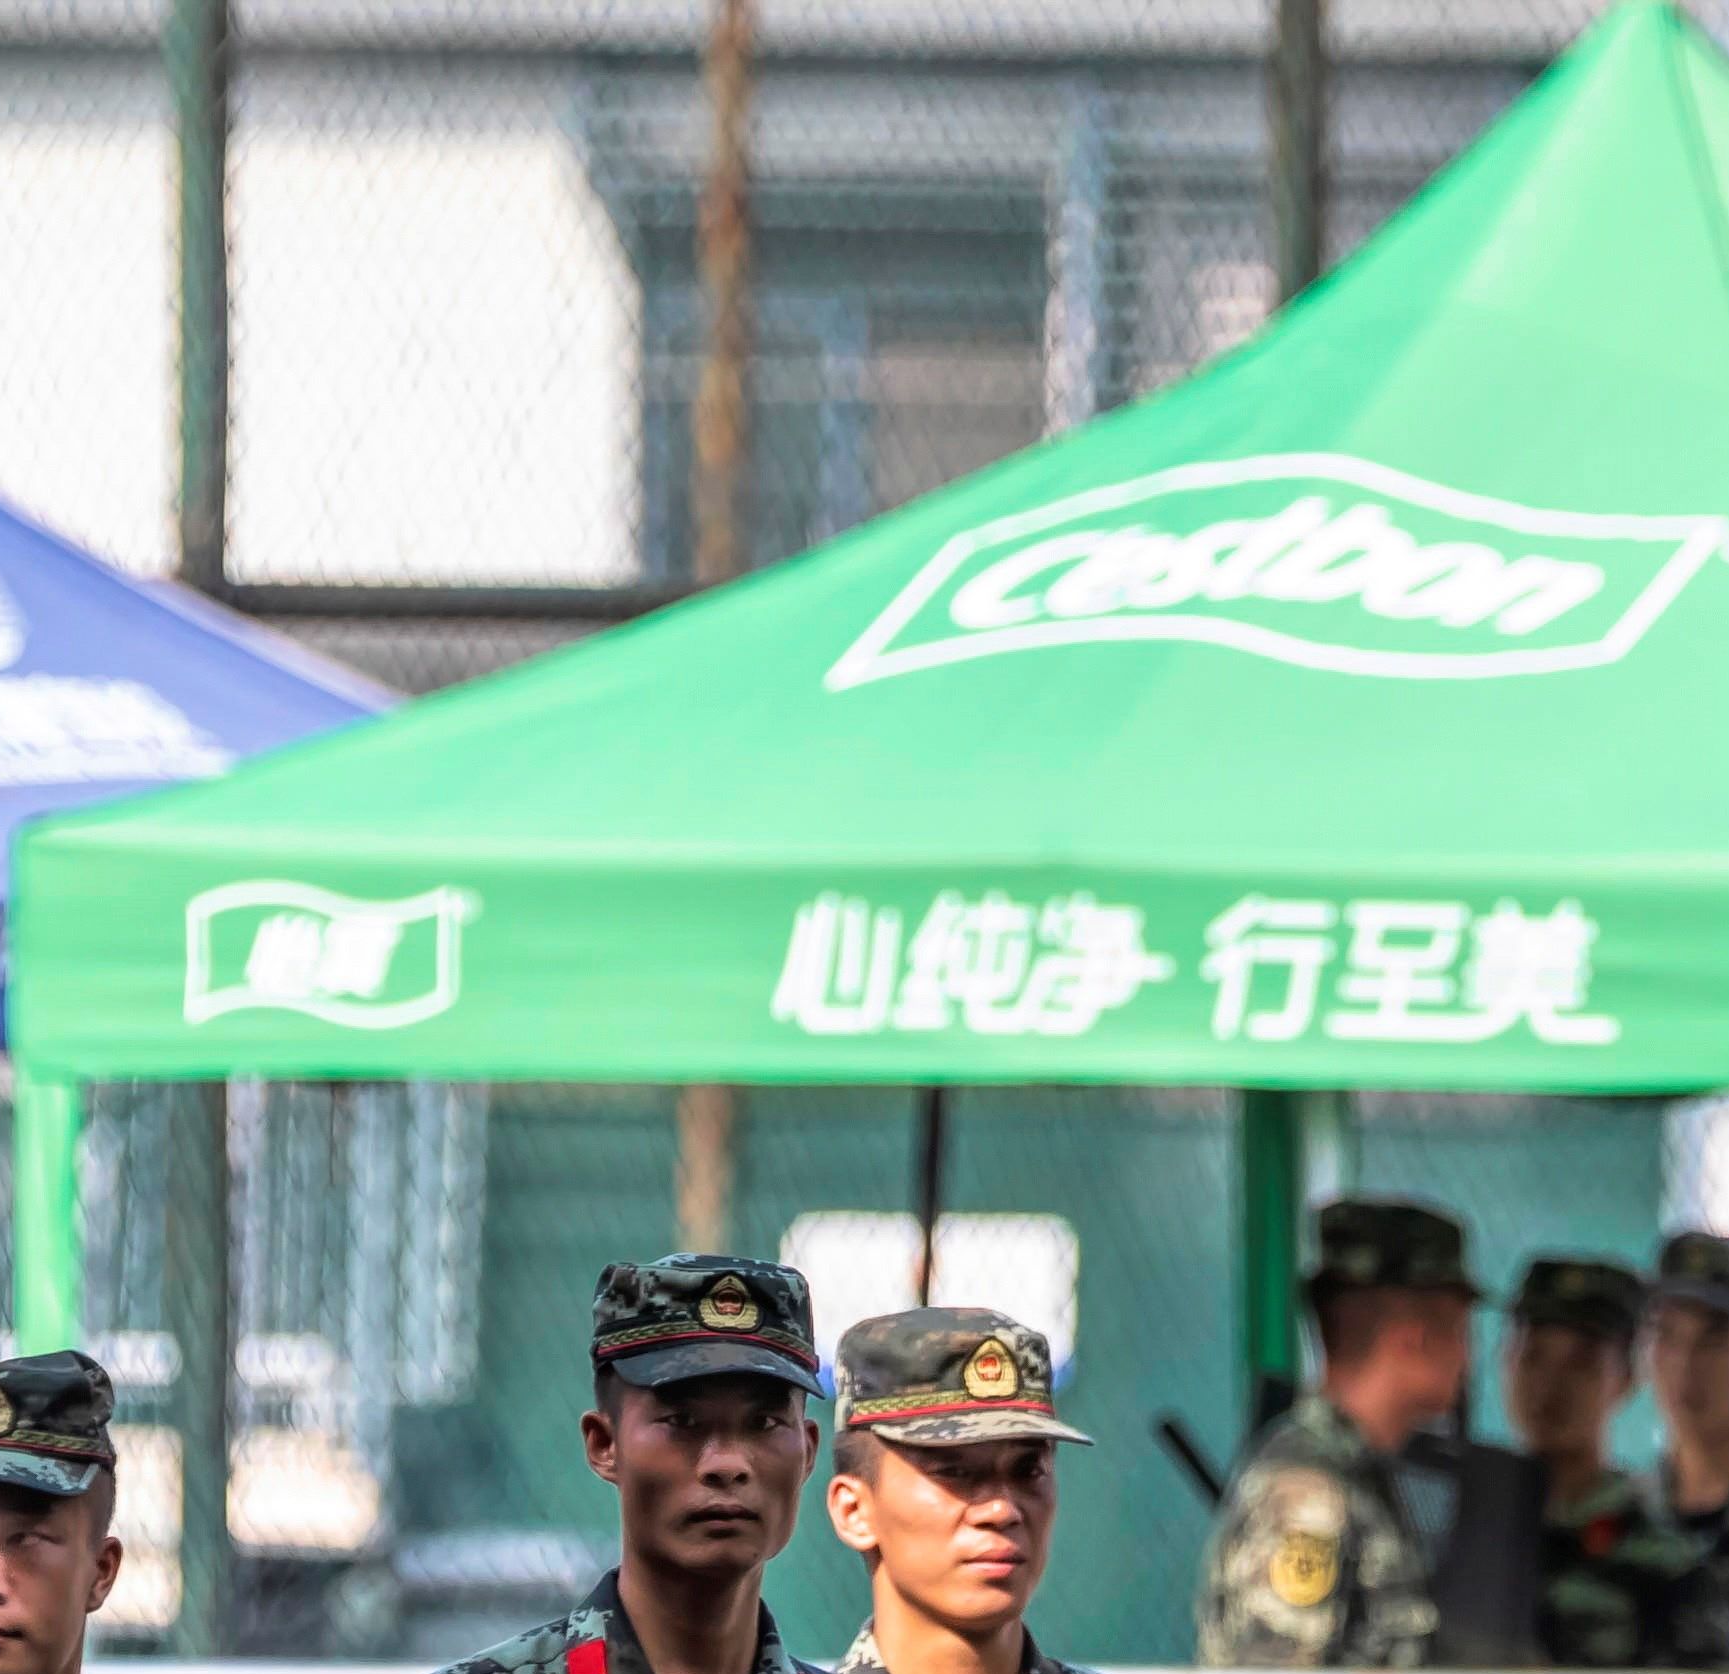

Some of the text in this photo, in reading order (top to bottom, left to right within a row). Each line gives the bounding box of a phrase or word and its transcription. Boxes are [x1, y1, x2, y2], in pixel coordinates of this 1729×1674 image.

[771, 893, 1621, 1046] 心纯净 行至美
